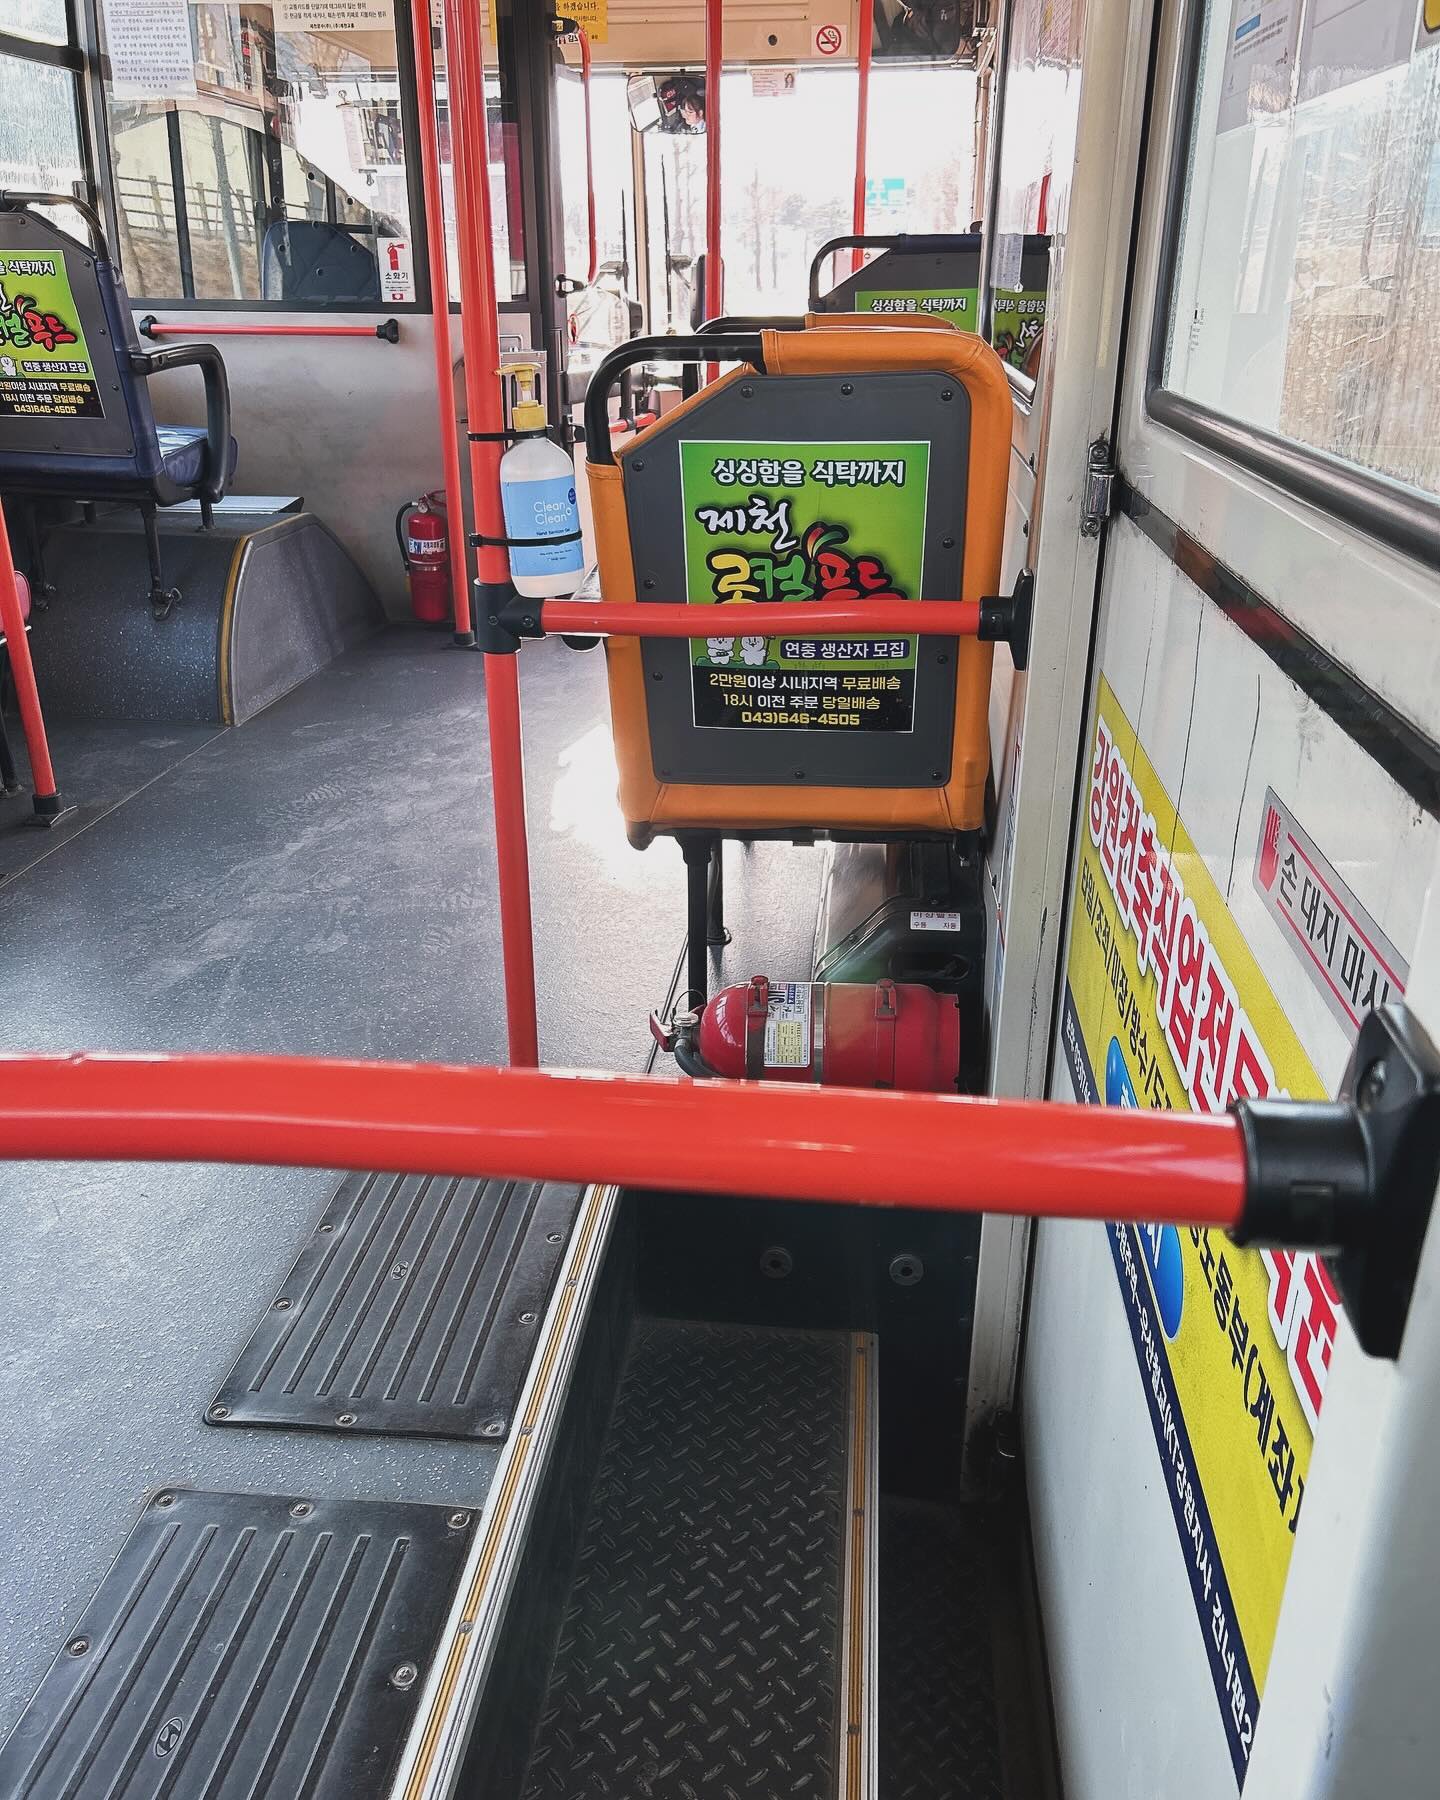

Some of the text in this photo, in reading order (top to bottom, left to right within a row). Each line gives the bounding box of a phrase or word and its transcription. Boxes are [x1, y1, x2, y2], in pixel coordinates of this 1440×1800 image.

[563, 2, 600, 11] 하겠습니다.
[8, 260, 56, 276] 식탁까지
[385, 272, 409, 280] 소화기
[871, 298, 967, 312] 싱싱함을 식탁까지
[0, 308, 77, 352] 컬푸드
[24, 362, 87, 373] 연중 생산자 모집
[0, 382, 91, 392] 원이상 시내지역 무료배송
[2, 394, 84, 404] 18시 이전 주문 당일배송
[15, 404, 77, 414] 043)646-4505
[713, 459, 905, 486] 싱싱함을 식탁까지
[533, 500, 566, 513] Clean
[535, 512, 568, 525] Clean
[697, 495, 799, 551] 제천
[785, 642, 905, 658] 연중 생산자 모집
[710, 673, 901, 691] 2만원이상 시내지역 무료배송
[723, 693, 880, 710] 18시 이전 주문 당일배송
[742, 712, 860, 726] 043)646-4505
[1280, 852, 1390, 1010] 손 대지 마시
